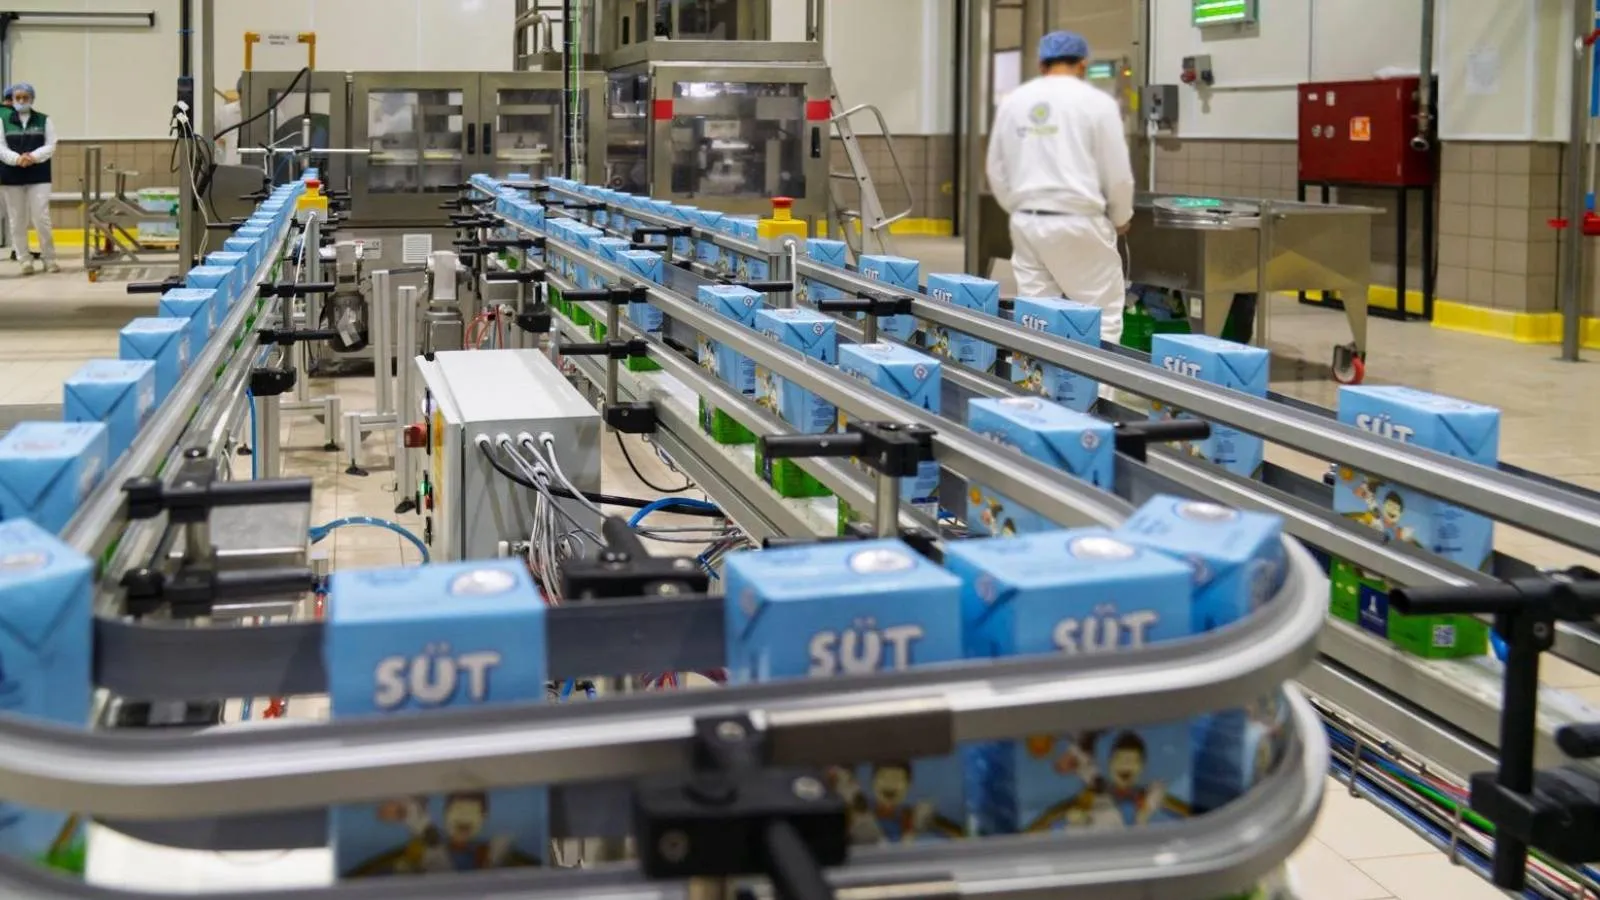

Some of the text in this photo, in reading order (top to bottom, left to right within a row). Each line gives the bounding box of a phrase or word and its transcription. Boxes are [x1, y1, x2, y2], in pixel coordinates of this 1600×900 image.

[932, 288, 953, 303] SÜT
[1022, 313, 1048, 332] SÜT
[1163, 354, 1202, 379] SÜT
[1356, 412, 1415, 443] SÜT
[1053, 602, 1160, 655] SÜT
[808, 616, 924, 677] SÜT
[374, 641, 501, 711] SÜT
